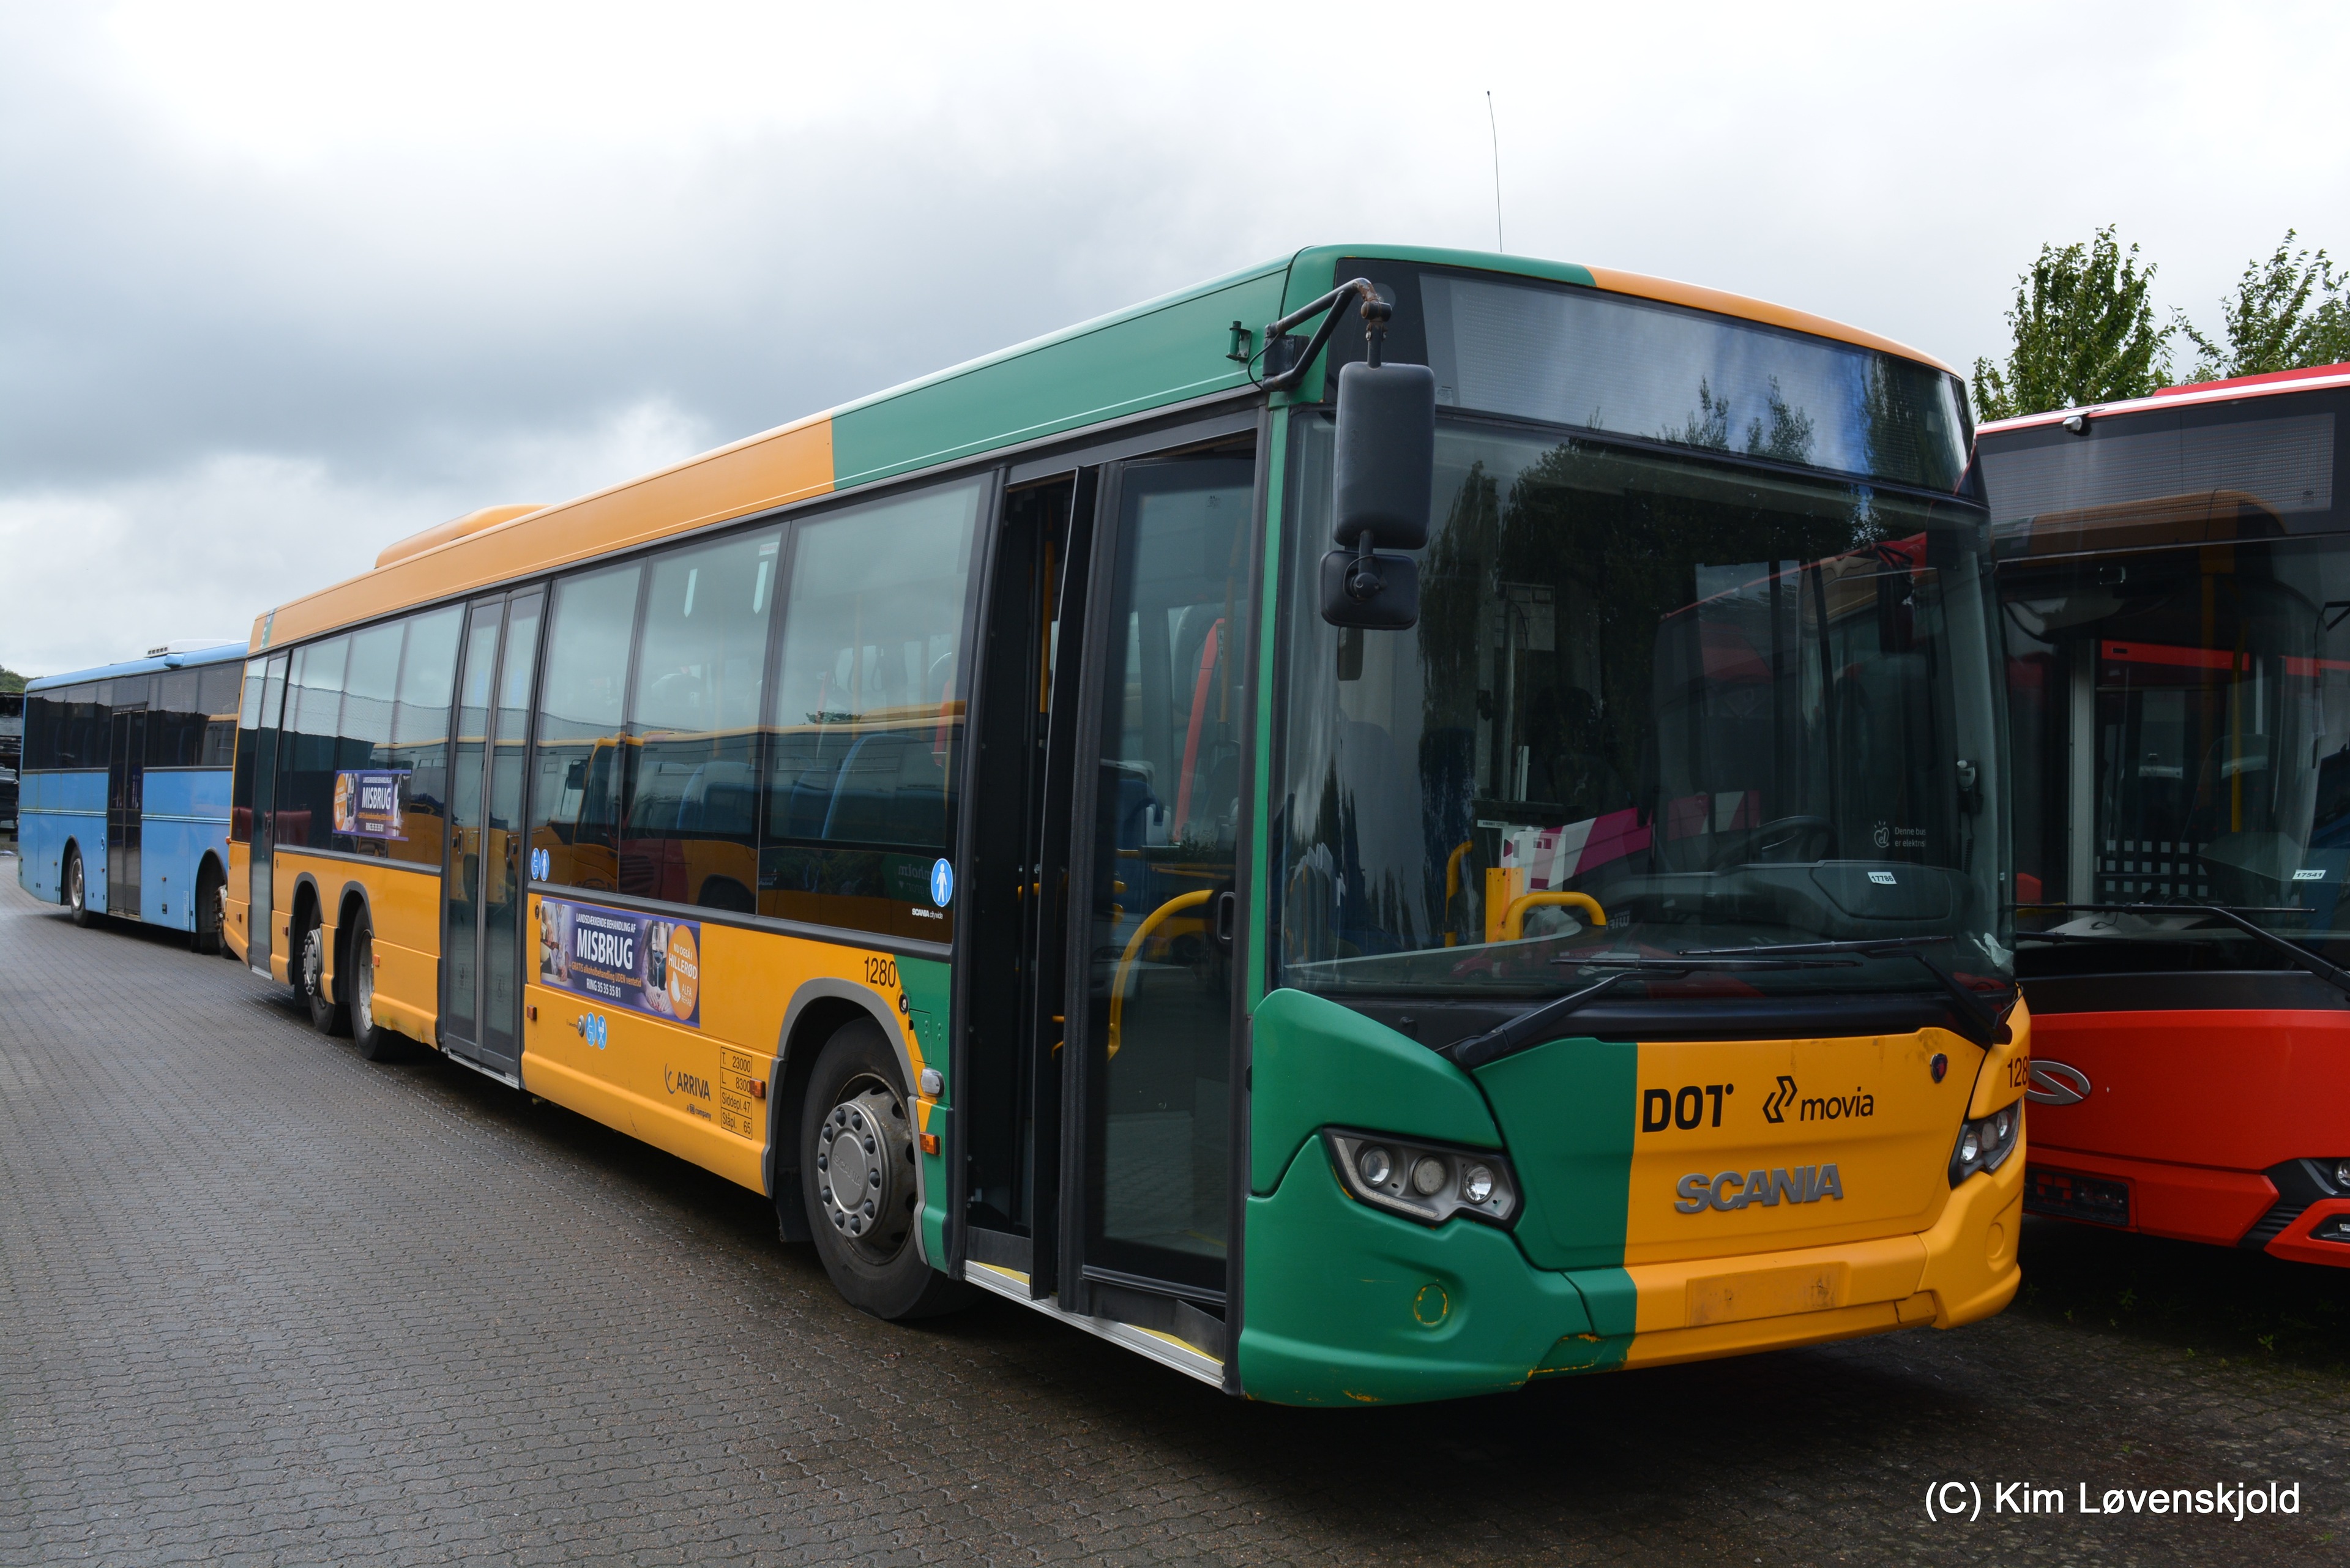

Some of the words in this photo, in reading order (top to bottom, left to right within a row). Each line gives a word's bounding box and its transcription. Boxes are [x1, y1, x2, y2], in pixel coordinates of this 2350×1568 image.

[362, 787, 391, 810] MISBRUG
[1895, 827, 1915, 835] Denne
[576, 913, 607, 928] LANDSDÆKKENDE
[606, 919, 631, 933] BEHANDLING
[630, 923, 636, 933] AF
[912, 908, 930, 917] SCANIA
[576, 928, 633, 970] MISBRUG
[674, 943, 680, 954] NU
[679, 946, 690, 960] OGSÅ
[668, 952, 698, 980] HILLERØD
[864, 956, 896, 988] 1280
[586, 978, 597, 991] RING
[597, 981, 603, 993] 35
[603, 982, 609, 995] 35
[609, 984, 615, 996] 35
[615, 986, 621, 998] 81
[615, 972, 626, 984] UDEN
[625, 977, 642, 987] ventetid
[681, 984, 692, 998] ALFA
[681, 995, 692, 1007] REHAB
[722, 1051, 726, 1065] T.
[732, 1056, 751, 1073] 23000
[2007, 1055, 2030, 1089] 128
[677, 1072, 711, 1102] ARRIVA
[736, 1077, 751, 1094] 8300
[722, 1092, 742, 1113] Siddepl.
[743, 1101, 750, 1114] 47
[1800, 1086, 1874, 1122] movia
[695, 1108, 711, 1121] company
[722, 1112, 737, 1130] Ståpl.
[744, 1121, 751, 1135] 65
[1674, 1163, 1844, 1214] SCANIA
